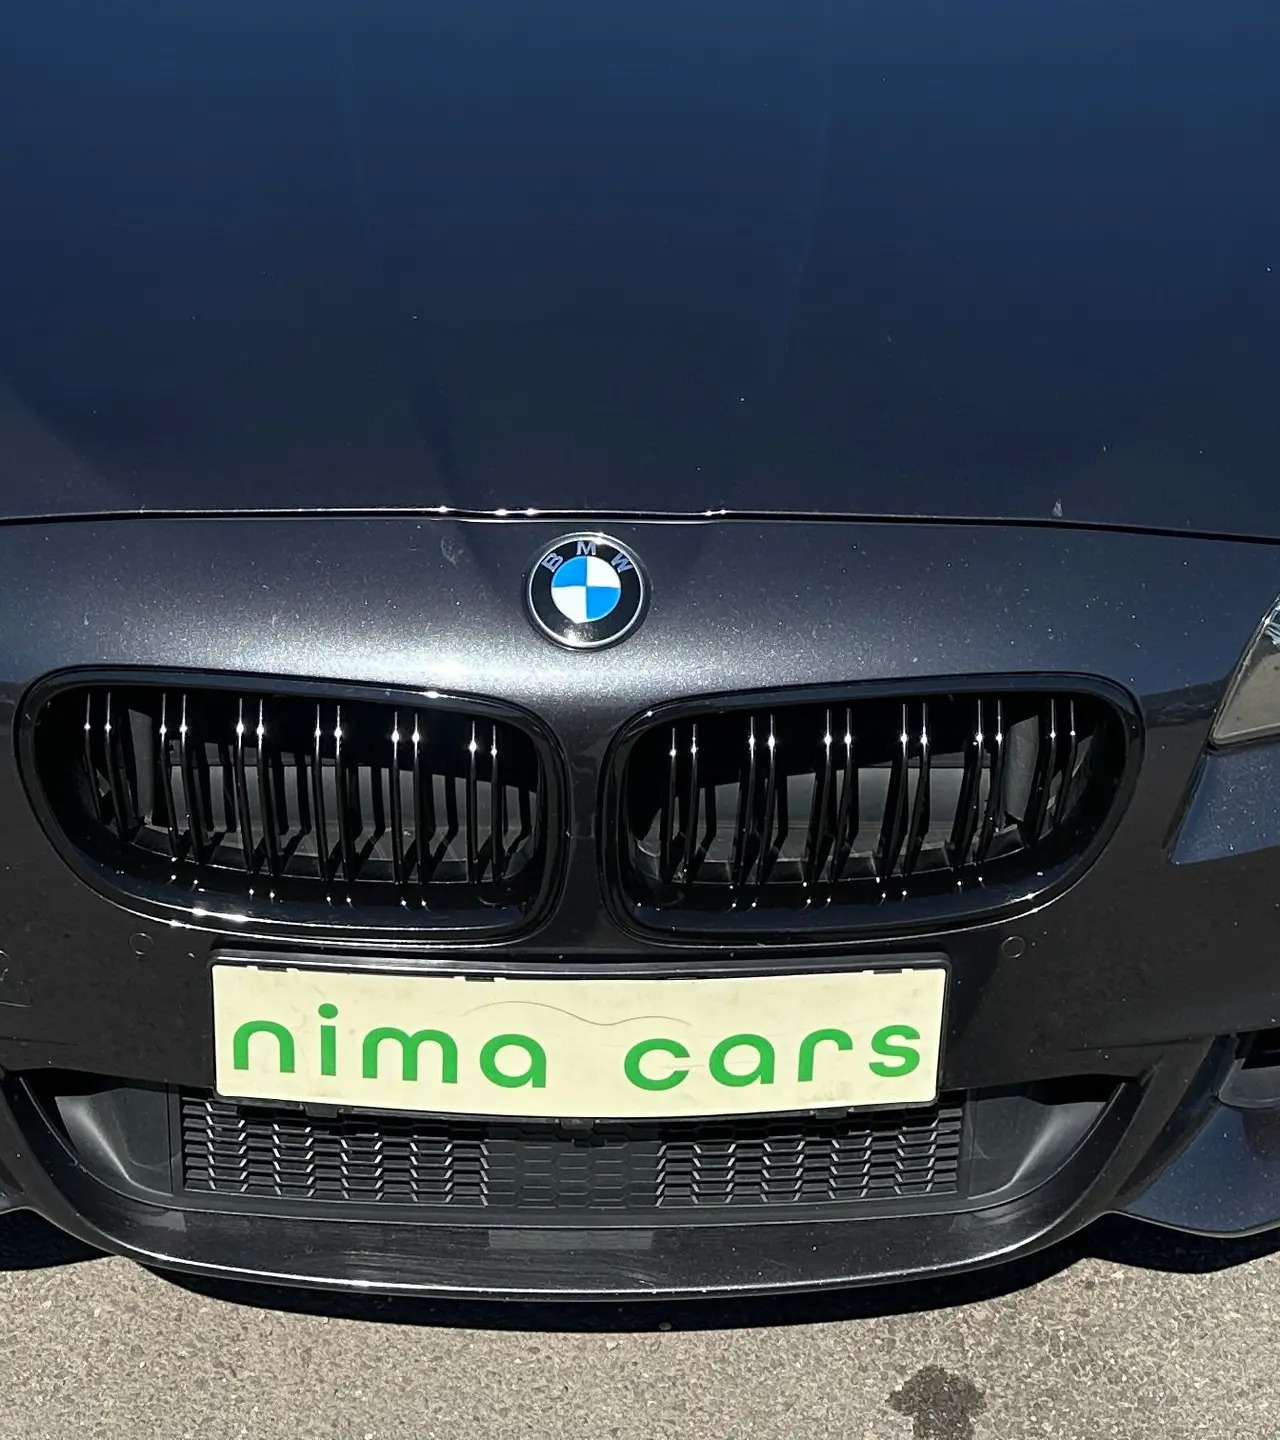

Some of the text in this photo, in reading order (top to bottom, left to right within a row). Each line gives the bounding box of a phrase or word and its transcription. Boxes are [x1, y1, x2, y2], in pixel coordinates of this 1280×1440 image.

[540, 540, 634, 574] BMW
[232, 1002, 921, 1092] nima cars
